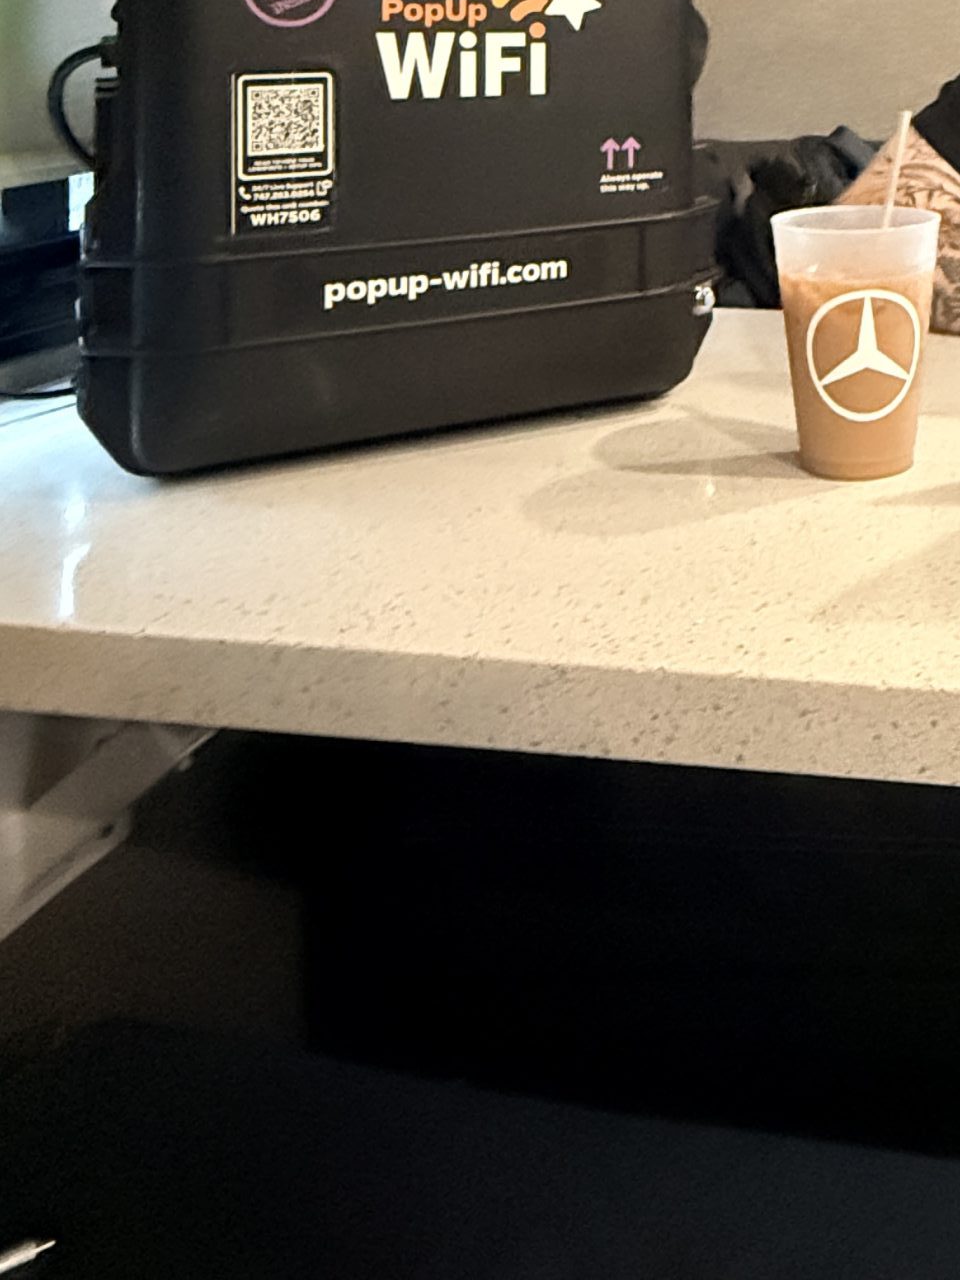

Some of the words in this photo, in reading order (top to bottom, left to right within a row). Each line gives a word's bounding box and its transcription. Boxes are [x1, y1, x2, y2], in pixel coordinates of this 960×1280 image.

[375, 22, 547, 100] WiFi
[250, 208, 321, 227] WH7506
[323, 259, 568, 310] popup-wifi.com
